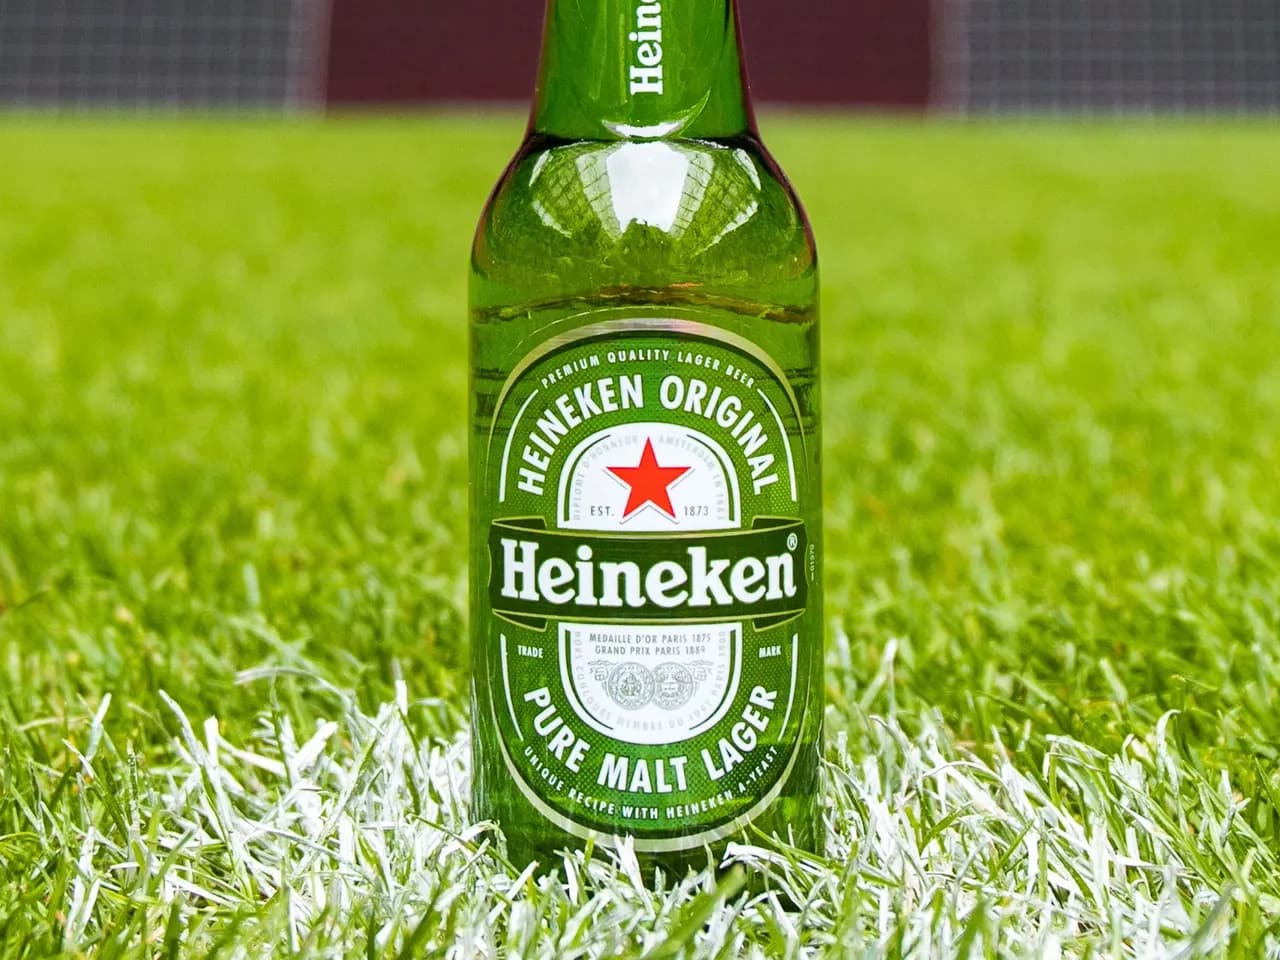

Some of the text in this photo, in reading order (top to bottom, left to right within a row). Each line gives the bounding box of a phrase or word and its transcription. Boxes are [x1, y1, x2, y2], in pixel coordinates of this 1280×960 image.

[541, 349, 755, 389] PREMIUM QUALITY LAGER BEER
[517, 374, 779, 496] HEINEKEN ORIGINAL
[590, 505, 615, 517] EST.
[684, 505, 709, 517] 1873
[518, 645, 782, 659] TRADE MARK
[589, 633, 631, 644] MEDAILLE
[636, 635, 657, 644] D'OR
[662, 634, 688, 644] PARIS
[595, 645, 626, 655] GRAND
[630, 646, 651, 656] PRIX
[655, 646, 680, 656] PARIS
[524, 685, 778, 793] PURE MALT LAGER
[524, 745, 778, 819] UNIQUE RECIPE WITH HEINEKEN A-YEAST
